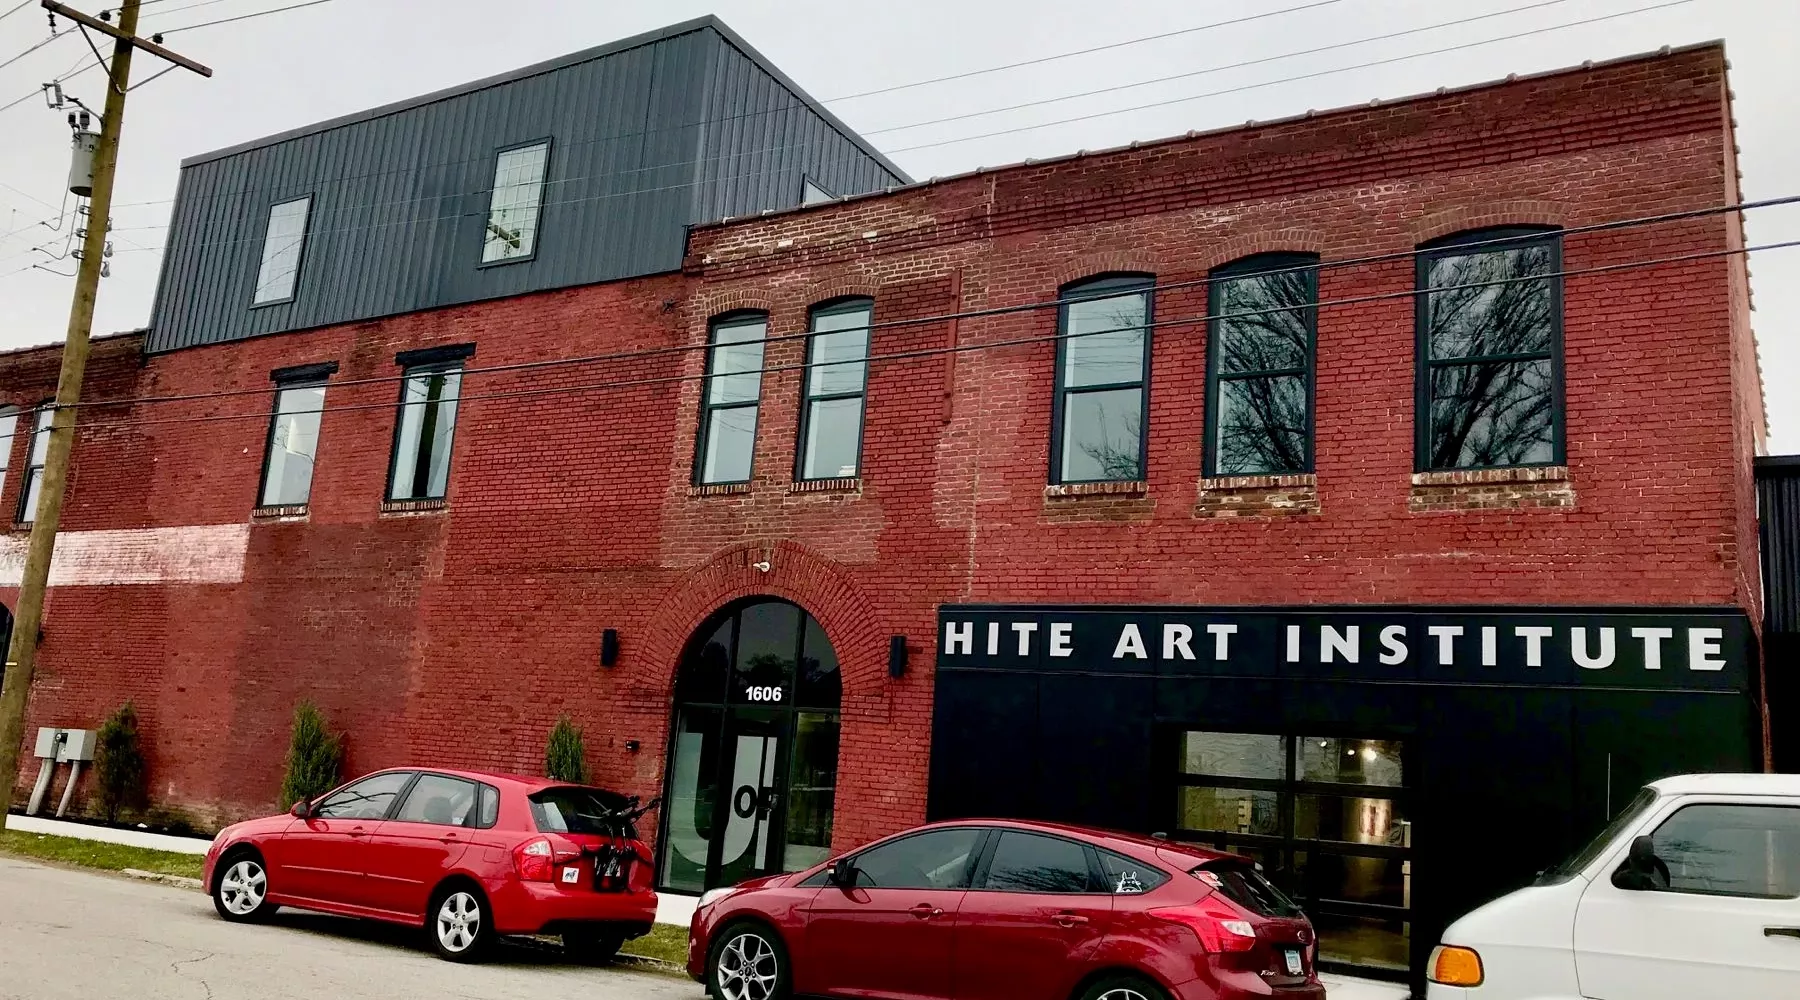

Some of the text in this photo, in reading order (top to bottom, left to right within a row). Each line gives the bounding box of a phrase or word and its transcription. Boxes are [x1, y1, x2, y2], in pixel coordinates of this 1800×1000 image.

[944, 621, 1727, 671] HITE ART INSTITUTE
[745, 685, 783, 702] 1606
